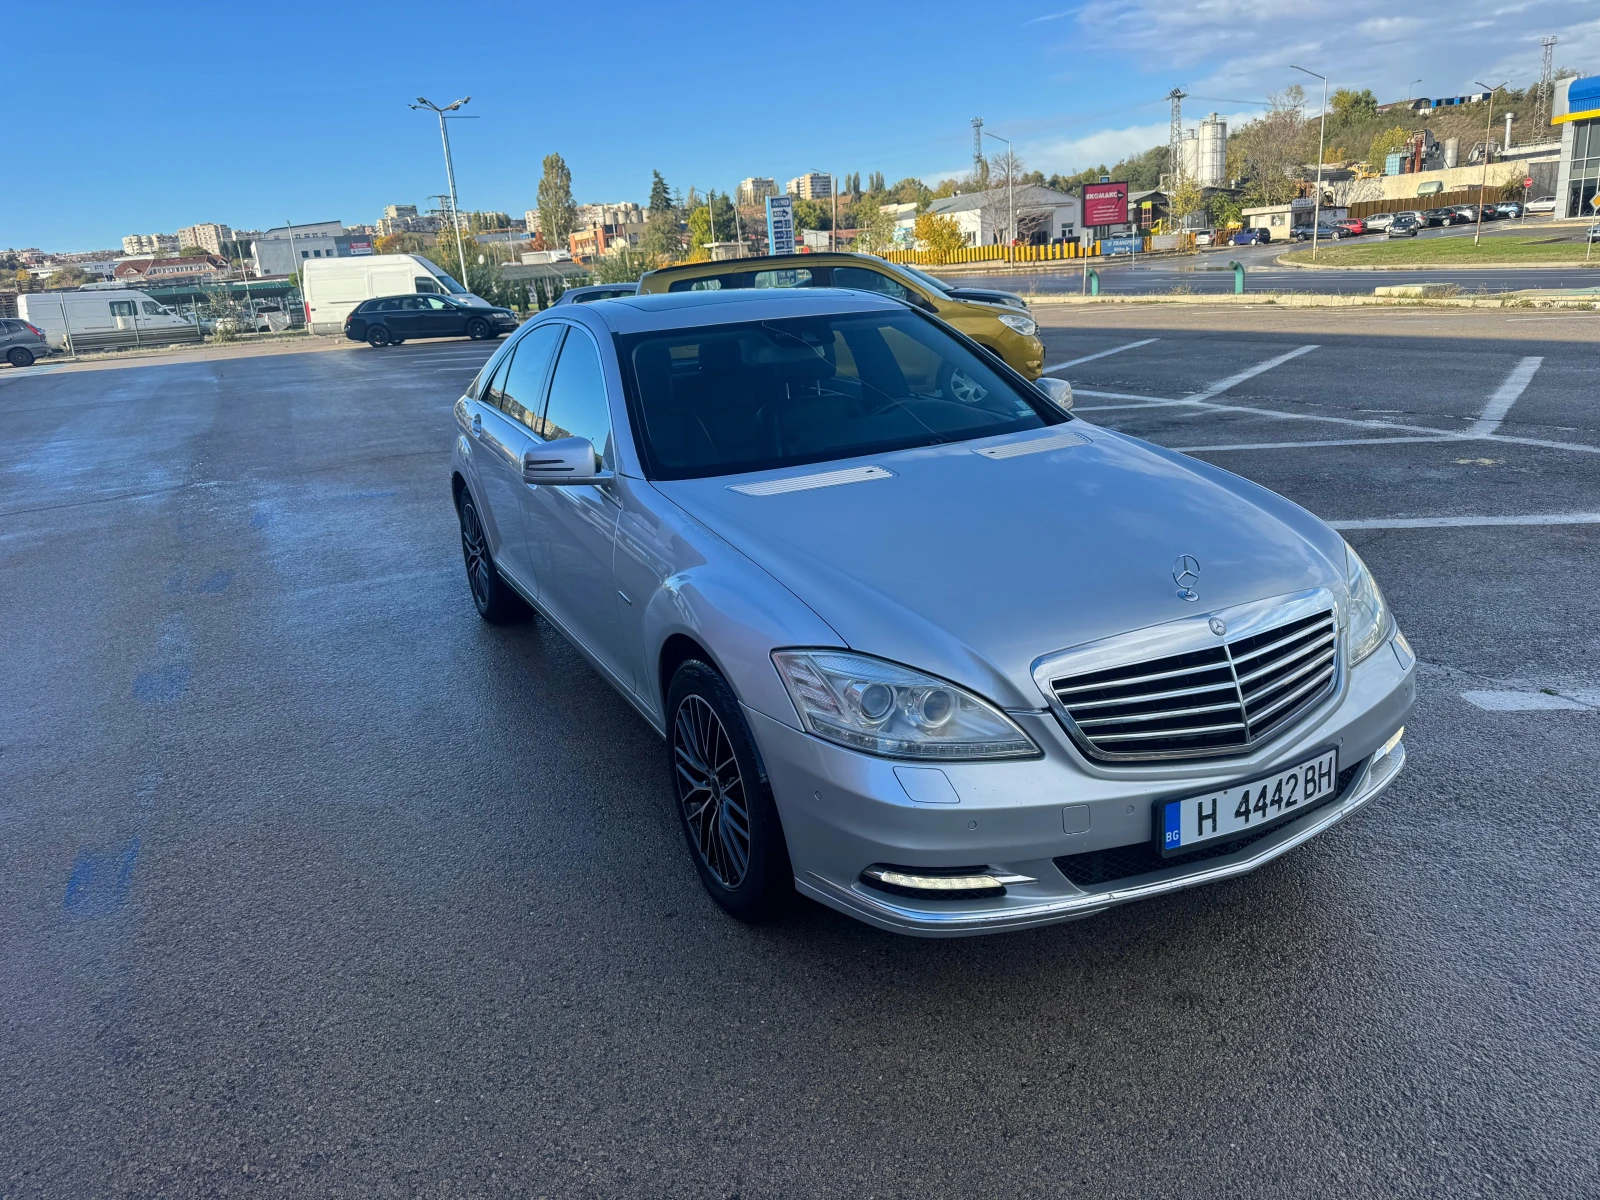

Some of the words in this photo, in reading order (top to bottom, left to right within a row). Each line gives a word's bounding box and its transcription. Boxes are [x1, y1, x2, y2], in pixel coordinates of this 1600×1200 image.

[1197, 797, 1217, 837] H
[1234, 773, 1300, 824] 4442
[1304, 756, 1333, 801] BH
[1165, 830, 1180, 843] BG
